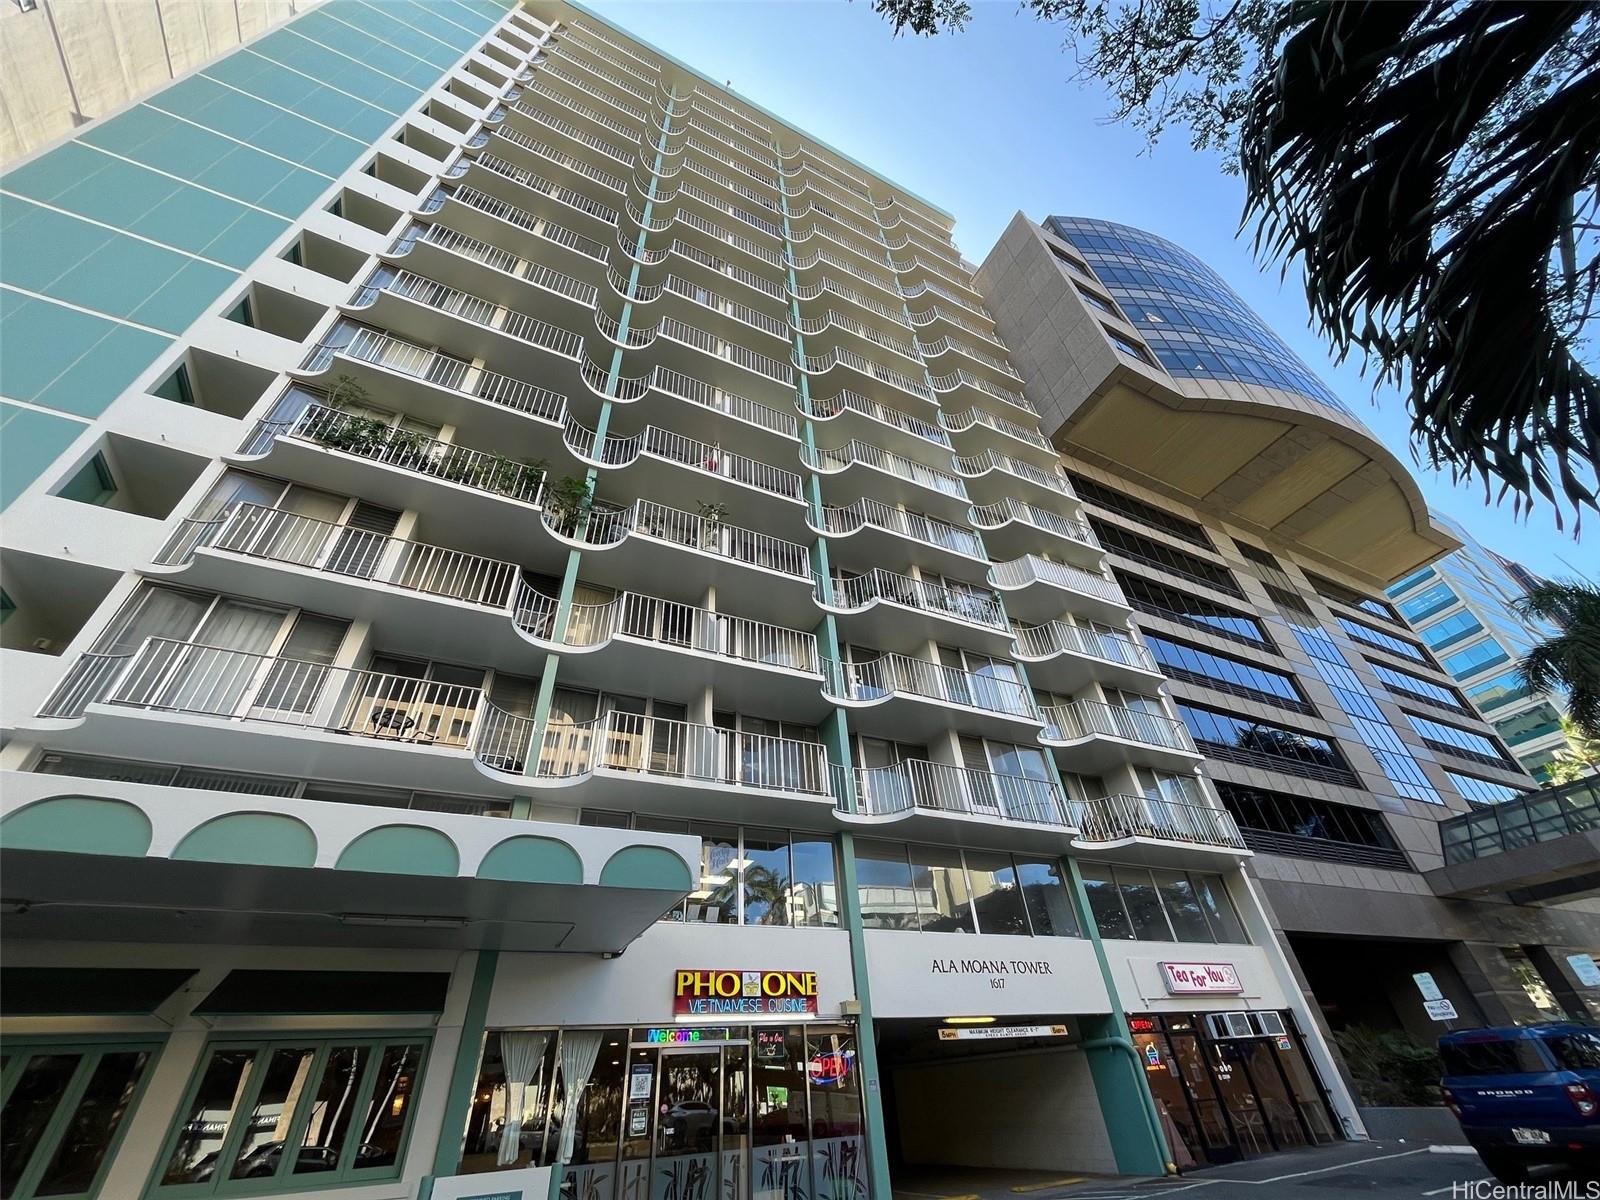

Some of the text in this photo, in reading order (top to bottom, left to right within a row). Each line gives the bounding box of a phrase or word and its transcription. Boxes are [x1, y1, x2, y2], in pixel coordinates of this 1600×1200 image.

[932, 960, 1053, 974] ALA MOANA TOWER
[1167, 965, 1225, 987] Tea For You
[676, 972, 818, 996] PHO ONE
[990, 979, 1005, 989] 1617
[688, 998, 808, 1014] VIETNAMESE CUISINE
[1131, 1020, 1153, 1029] OPEN
[648, 1028, 700, 1042] Welcome
[811, 1056, 849, 1078] OPEN
